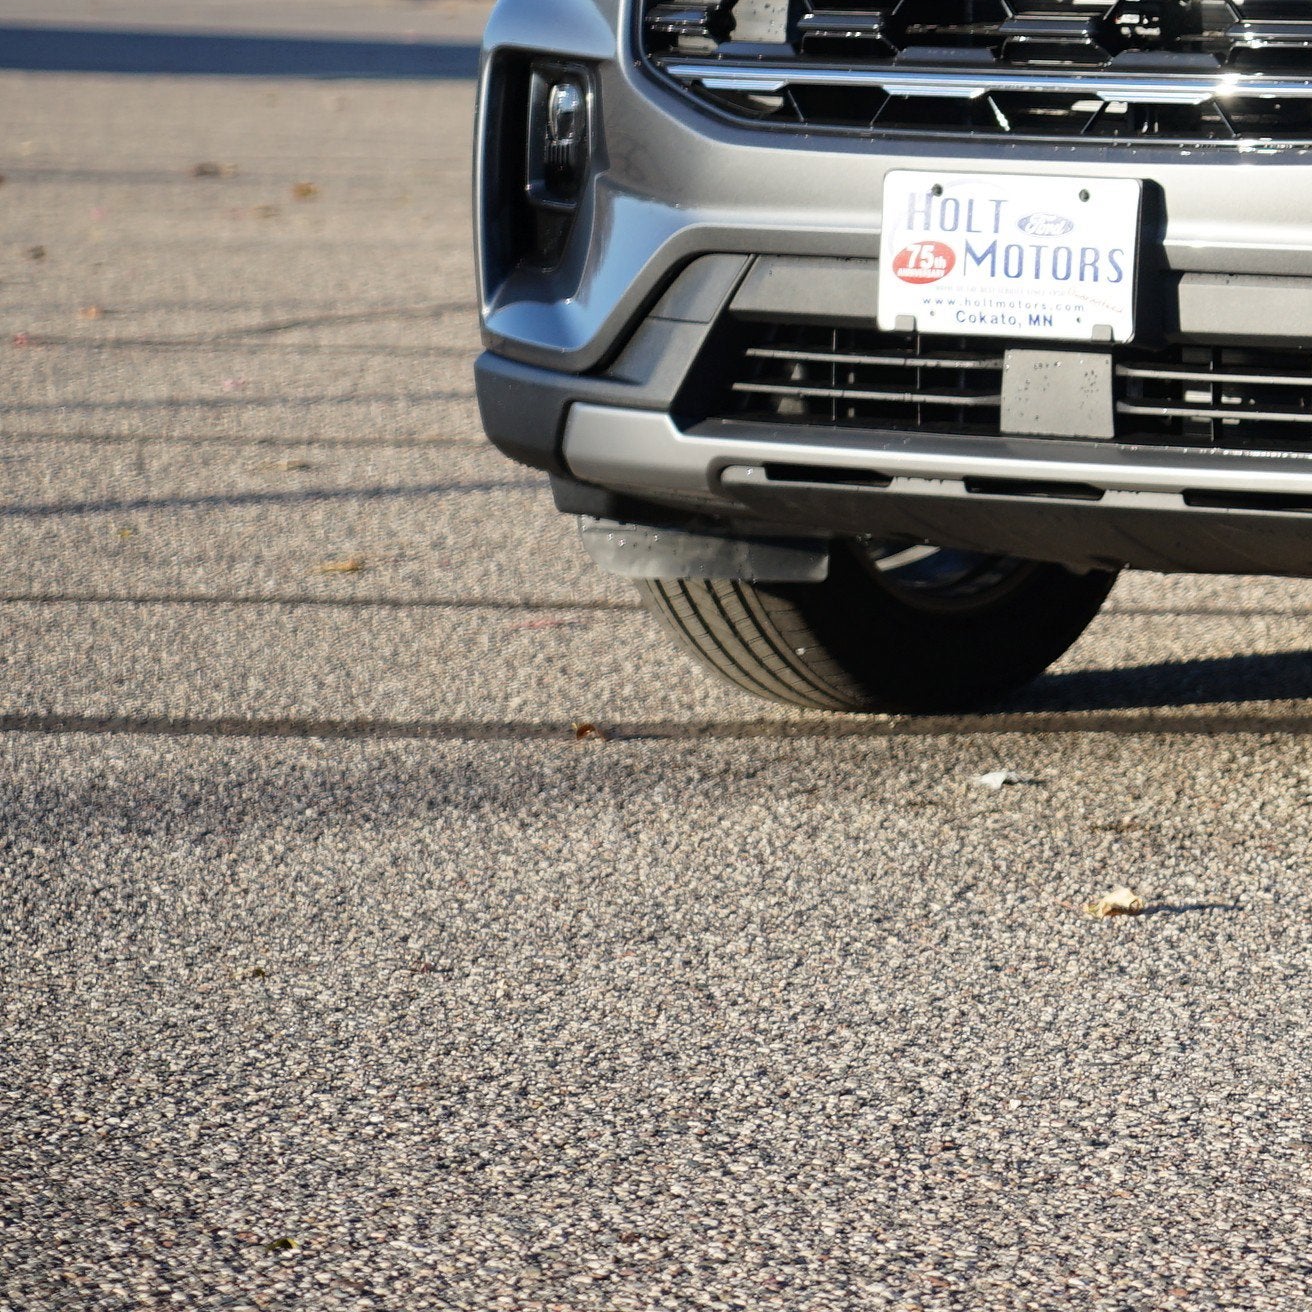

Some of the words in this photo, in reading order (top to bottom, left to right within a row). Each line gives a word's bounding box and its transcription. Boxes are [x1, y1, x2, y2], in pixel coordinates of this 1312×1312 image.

[906, 191, 1008, 233] HOLT
[1022, 214, 1070, 235] Ford
[906, 244, 948, 270] 75th
[963, 238, 1125, 284] MOTORS
[922, 296, 1085, 312] www.holtmotors.com
[956, 310, 1022, 328] Cokato,
[1028, 314, 1053, 327] MN
